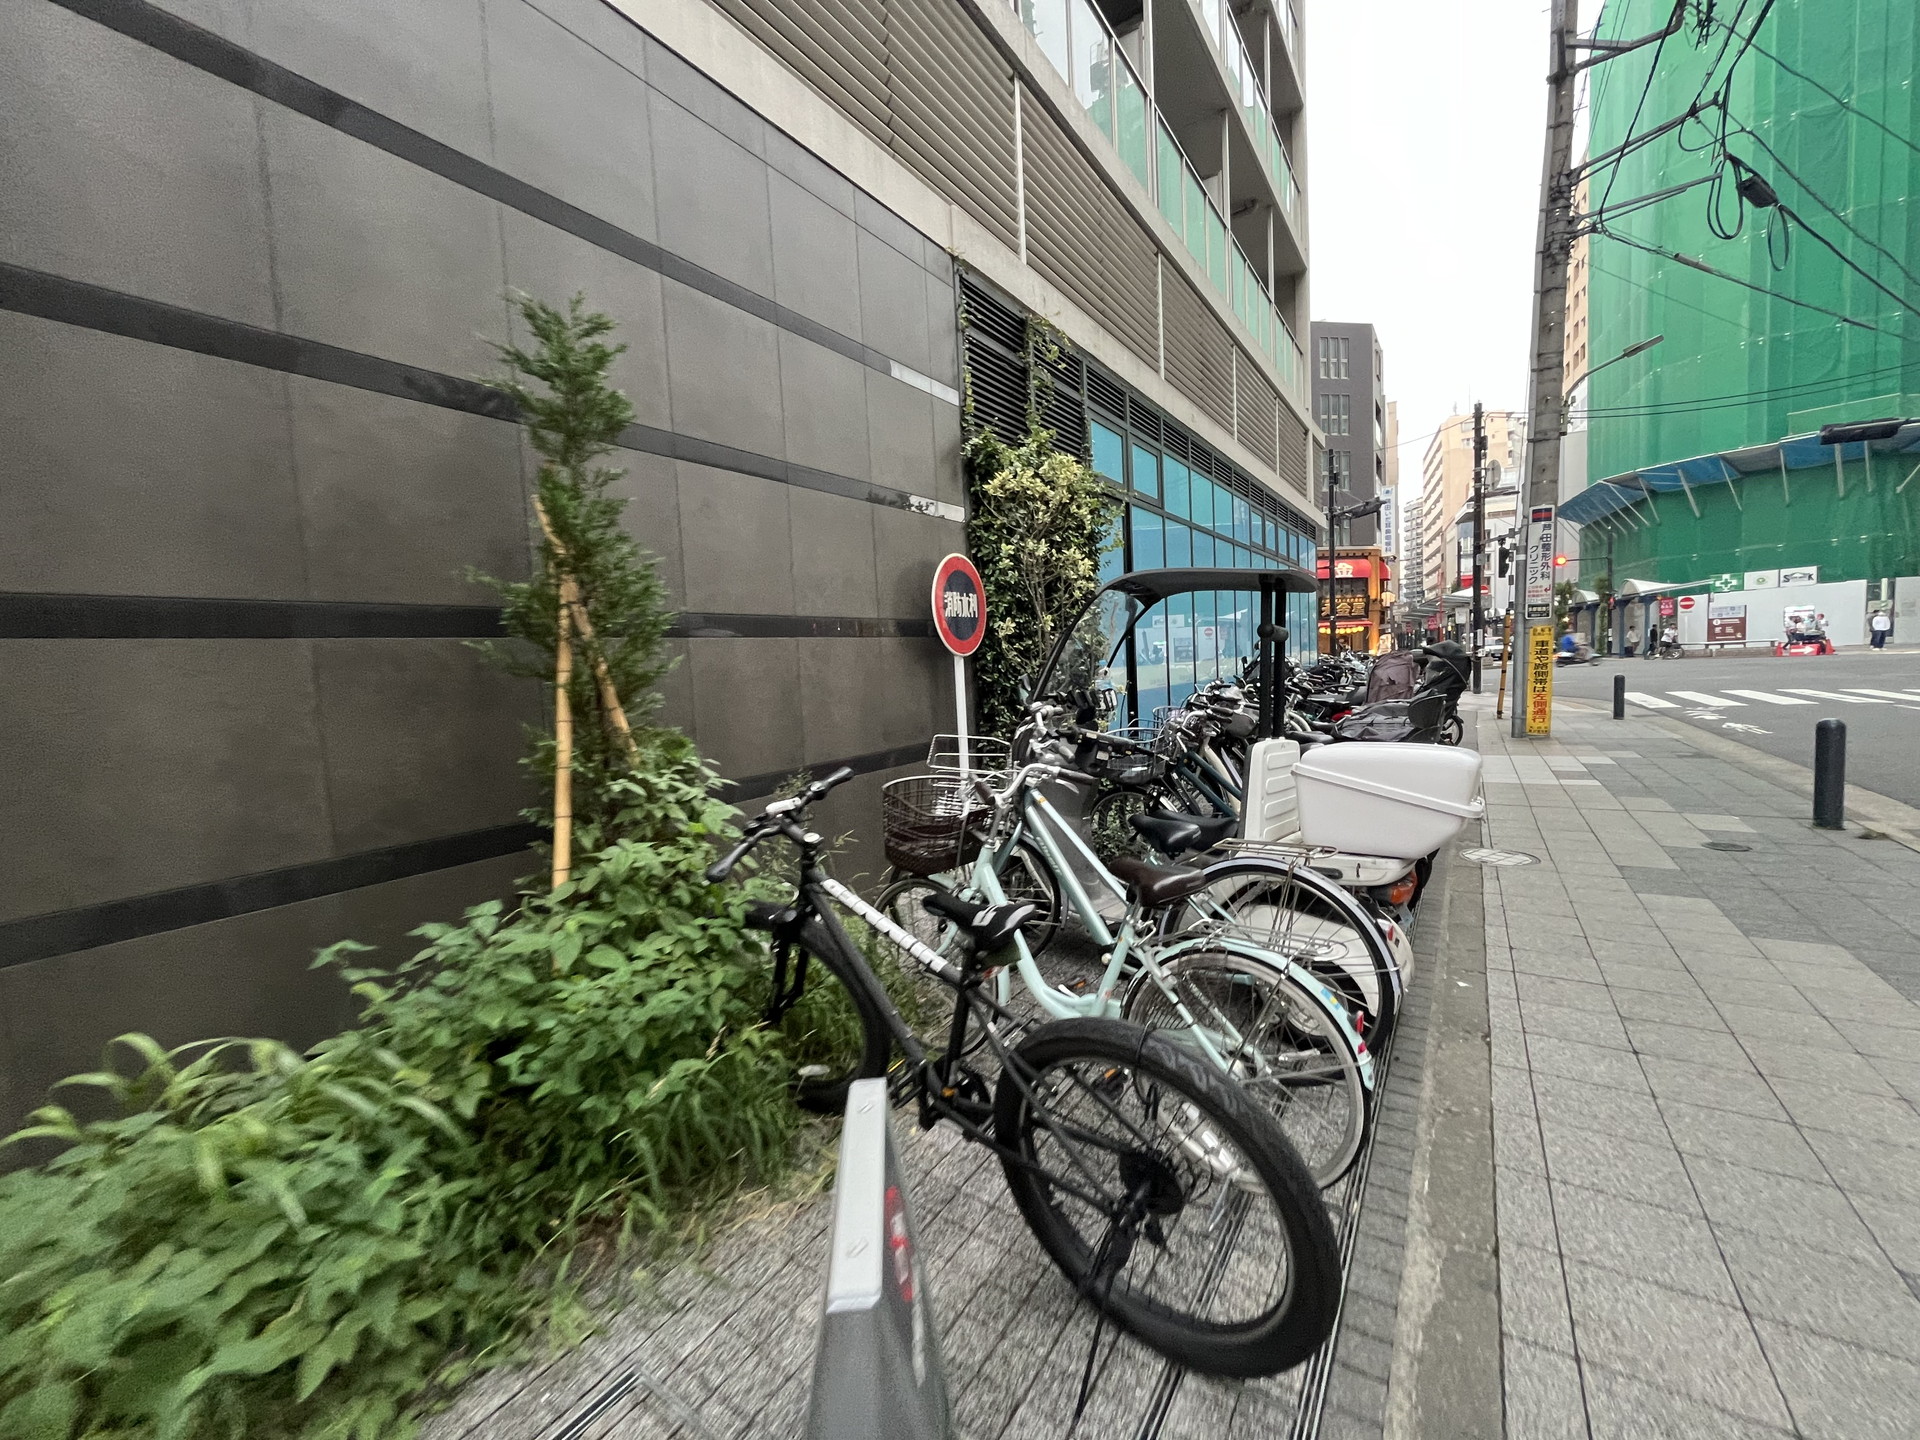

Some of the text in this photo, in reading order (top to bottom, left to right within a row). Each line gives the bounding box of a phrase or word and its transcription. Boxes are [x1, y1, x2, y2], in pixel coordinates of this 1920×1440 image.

[1528, 545, 1539, 585] クリニック
[943, 591, 978, 618] 消防水利
[1532, 640, 1549, 723] 車道や路側帯は左側通行
